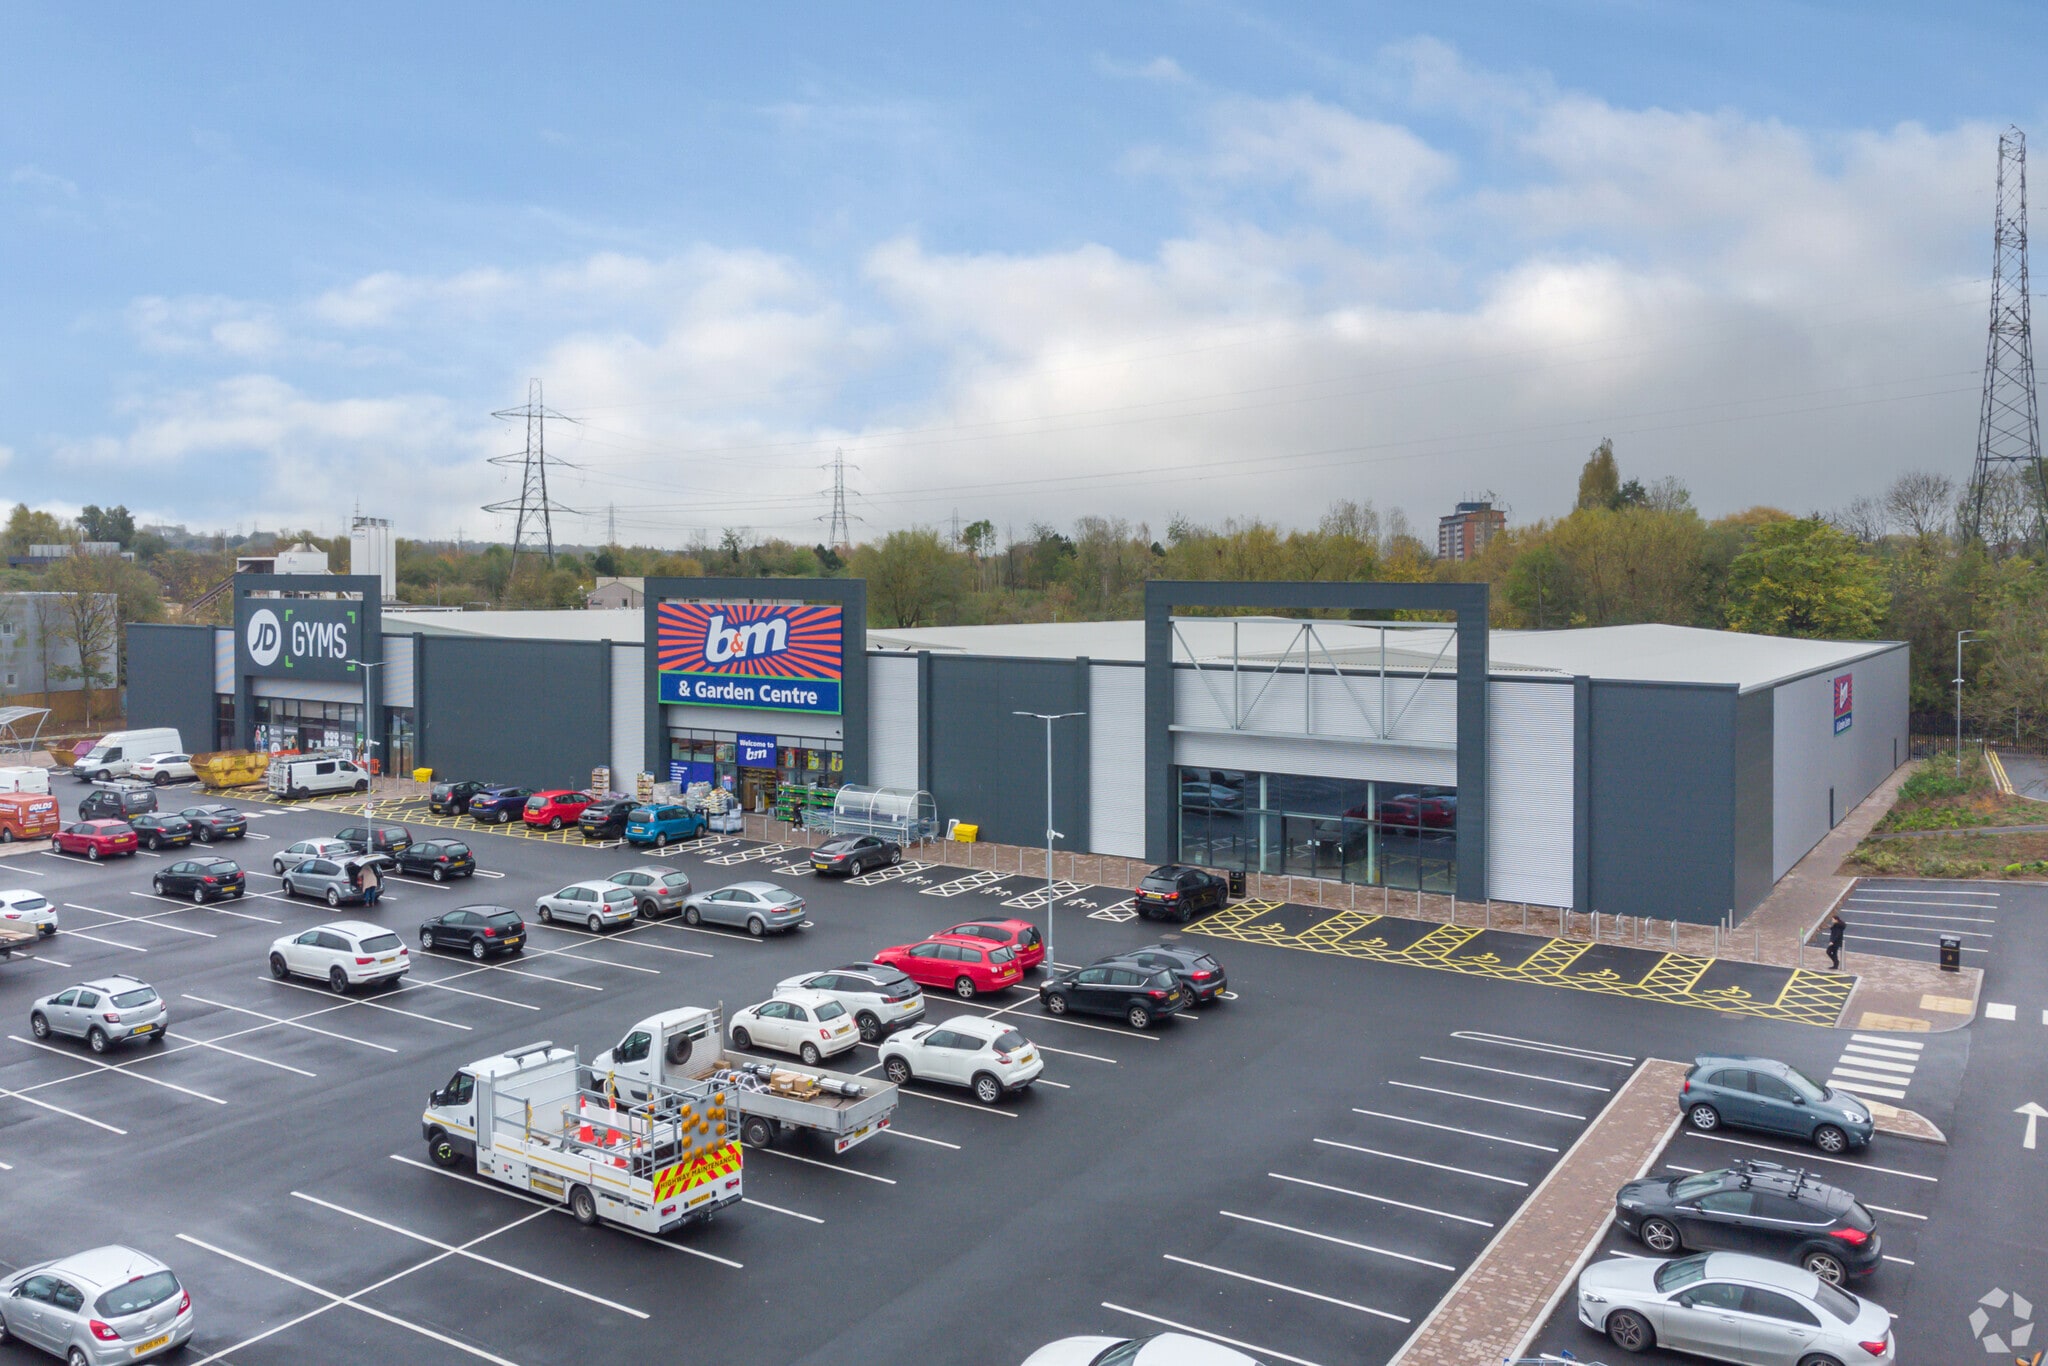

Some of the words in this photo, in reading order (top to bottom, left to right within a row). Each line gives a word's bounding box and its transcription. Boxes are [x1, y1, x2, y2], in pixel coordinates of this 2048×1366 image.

[252, 623, 277, 651] JD
[292, 620, 347, 659] GYMS
[705, 615, 788, 663] b&m
[678, 680, 691, 697] &
[695, 681, 755, 701] Garden
[759, 685, 818, 705] Centre
[739, 739, 766, 748] Welcome
[767, 741, 775, 749] to
[28, 801, 53, 812] GOLDS
[660, 1172, 690, 1190] HIGHWAY
[691, 1154, 736, 1177] MAINTENANCE
